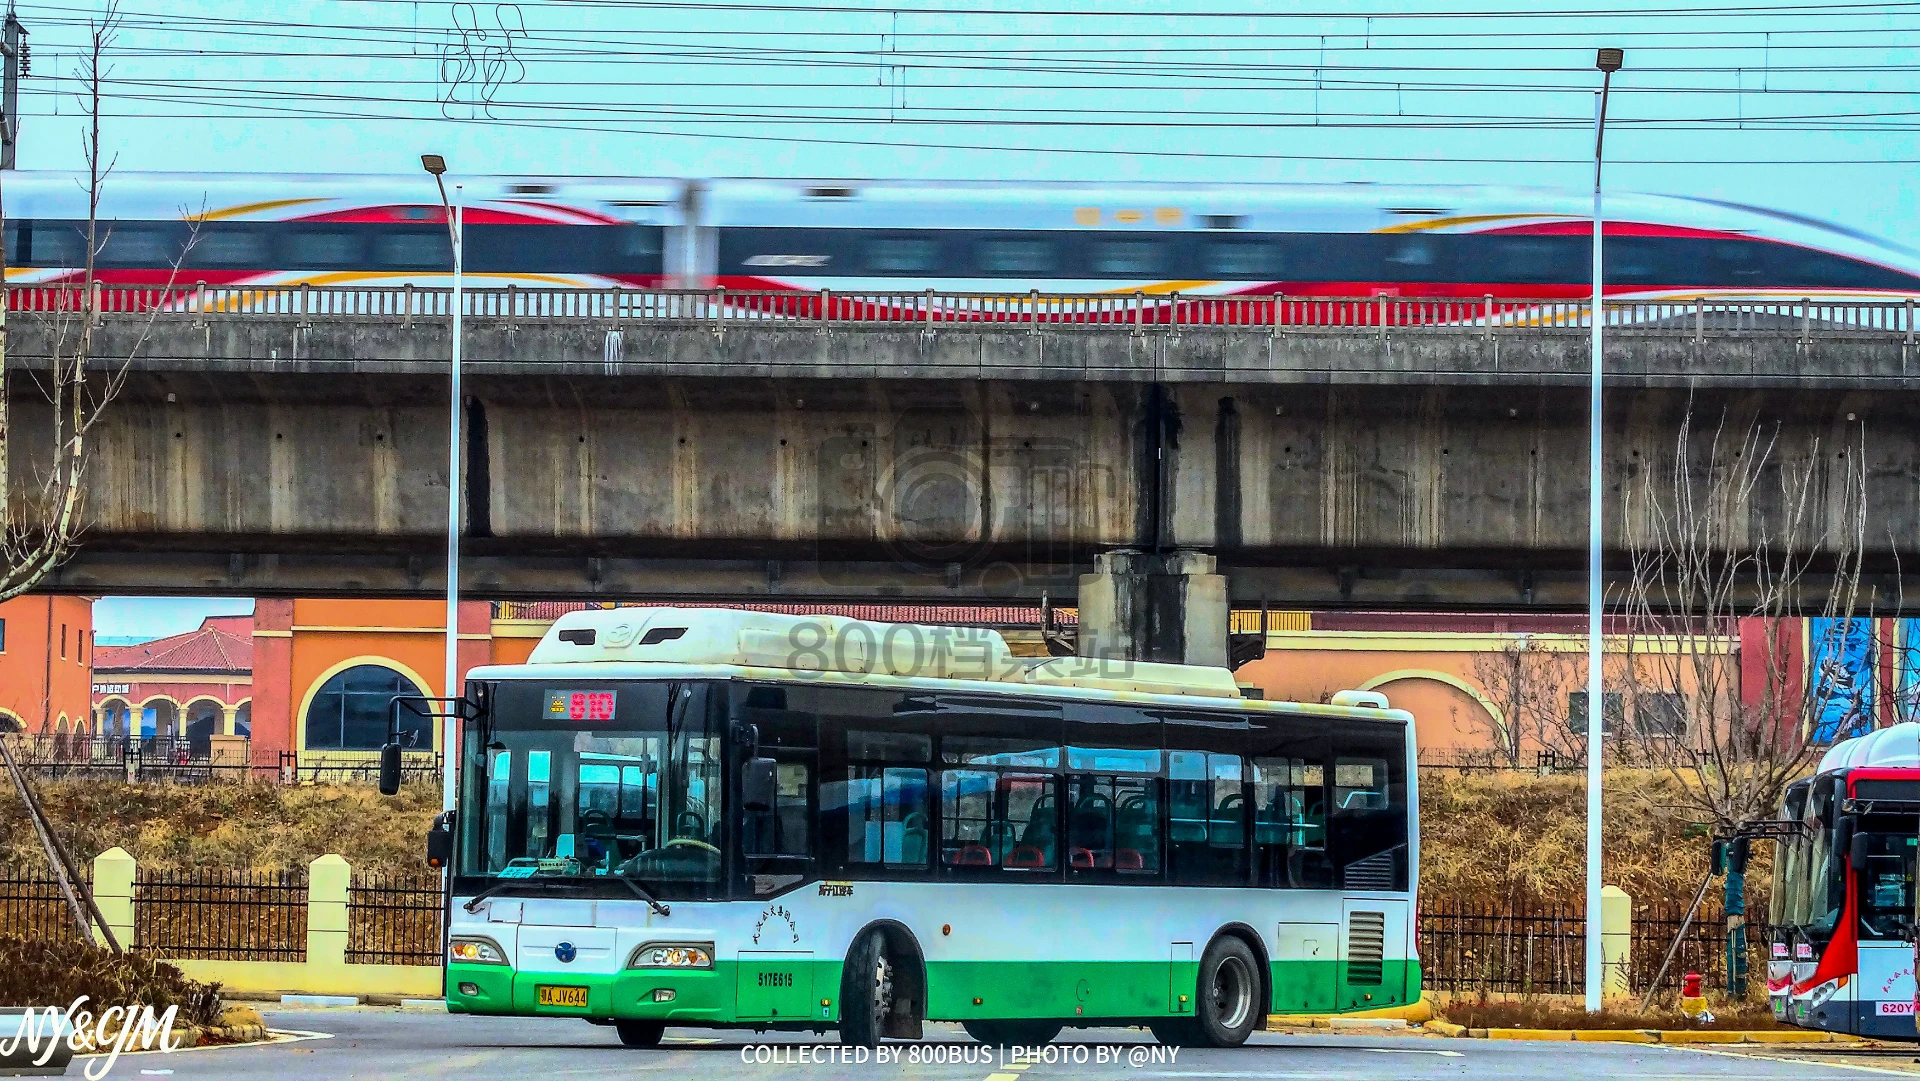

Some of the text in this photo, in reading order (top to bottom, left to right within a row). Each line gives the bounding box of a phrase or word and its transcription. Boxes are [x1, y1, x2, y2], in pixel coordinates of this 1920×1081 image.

[569, 692, 614, 720] 810
[757, 972, 794, 988] 517E615
[555, 989, 586, 1004] JV644
